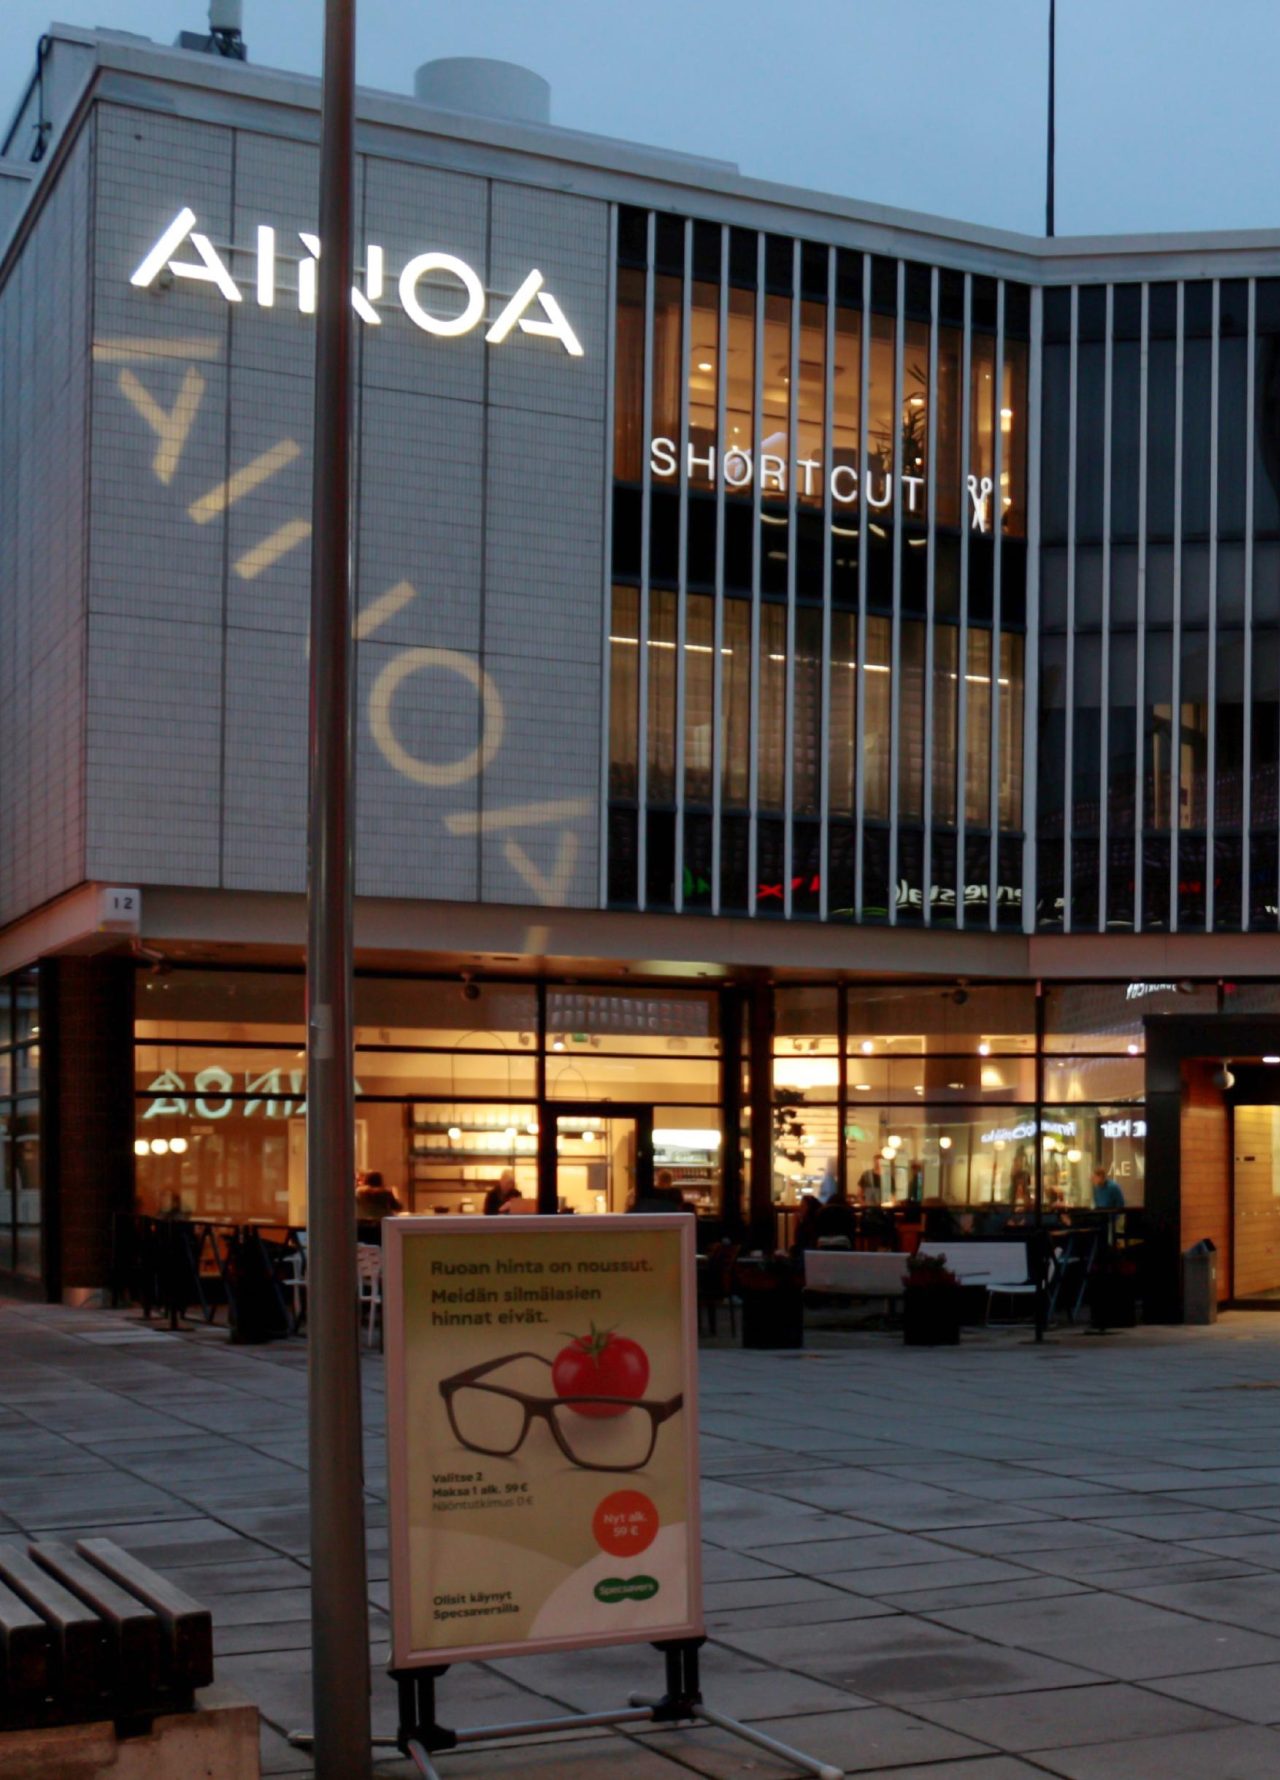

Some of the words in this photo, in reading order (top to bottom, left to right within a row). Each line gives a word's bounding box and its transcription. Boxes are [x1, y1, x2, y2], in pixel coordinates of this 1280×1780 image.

[130, 207, 584, 357] AINOA
[650, 436, 924, 511] SHORTCUT
[112, 895, 134, 911] 12
[431, 1260, 490, 1276] Ruoan
[496, 1259, 544, 1274] hinta
[550, 1261, 572, 1273] on
[577, 1259, 653, 1273] noussut.
[431, 1288, 499, 1304] Meidän
[504, 1286, 602, 1302] silmälasien
[431, 1309, 493, 1326] hinnat
[498, 1308, 548, 1325] eivät.
[432, 1473, 474, 1484] Valitse
[476, 1471, 483, 1481] 2
[432, 1487, 470, 1498] Maksa
[433, 1594, 466, 1606] Olisit
[470, 1591, 512, 1605] käynyt
[433, 1603, 520, 1621] Specsaversilla
